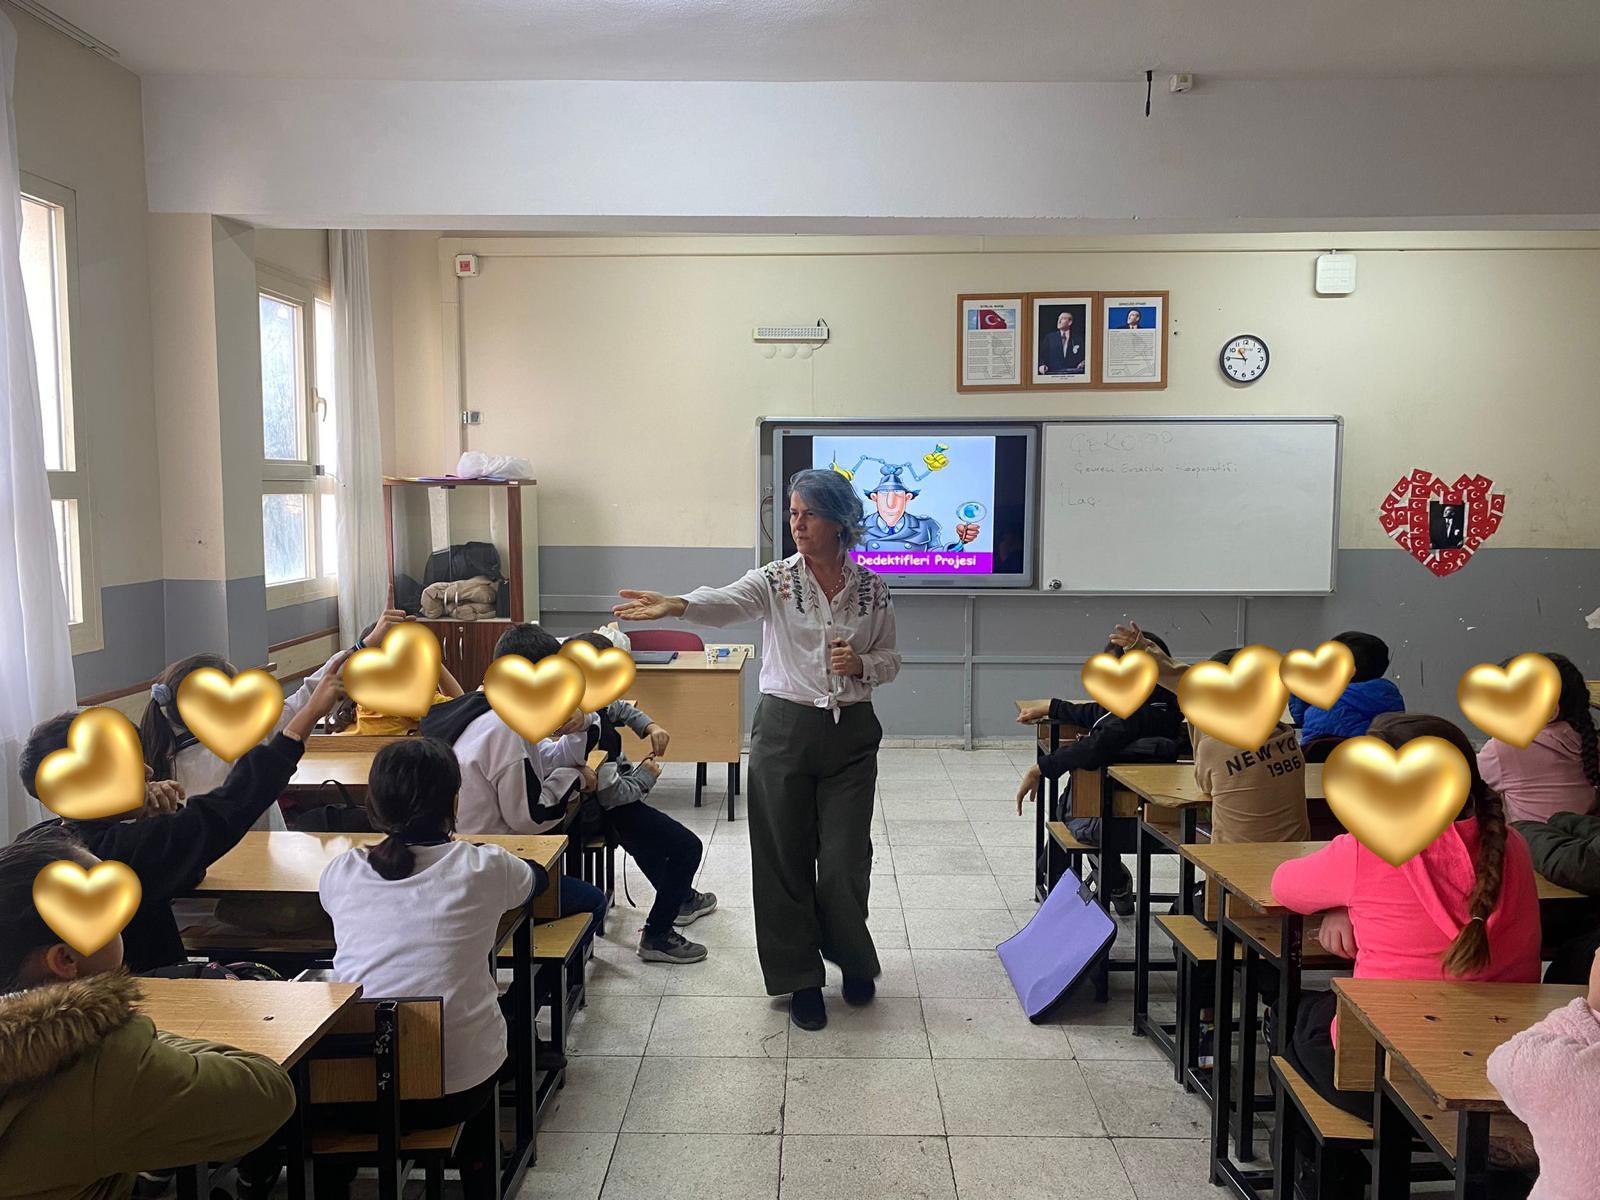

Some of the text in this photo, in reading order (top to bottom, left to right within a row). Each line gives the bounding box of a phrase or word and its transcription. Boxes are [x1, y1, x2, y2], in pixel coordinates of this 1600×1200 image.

[857, 554, 977, 569] Dedektifleri Projesi
[1225, 744, 1272, 776] NEW
[1267, 756, 1302, 778] 1986
